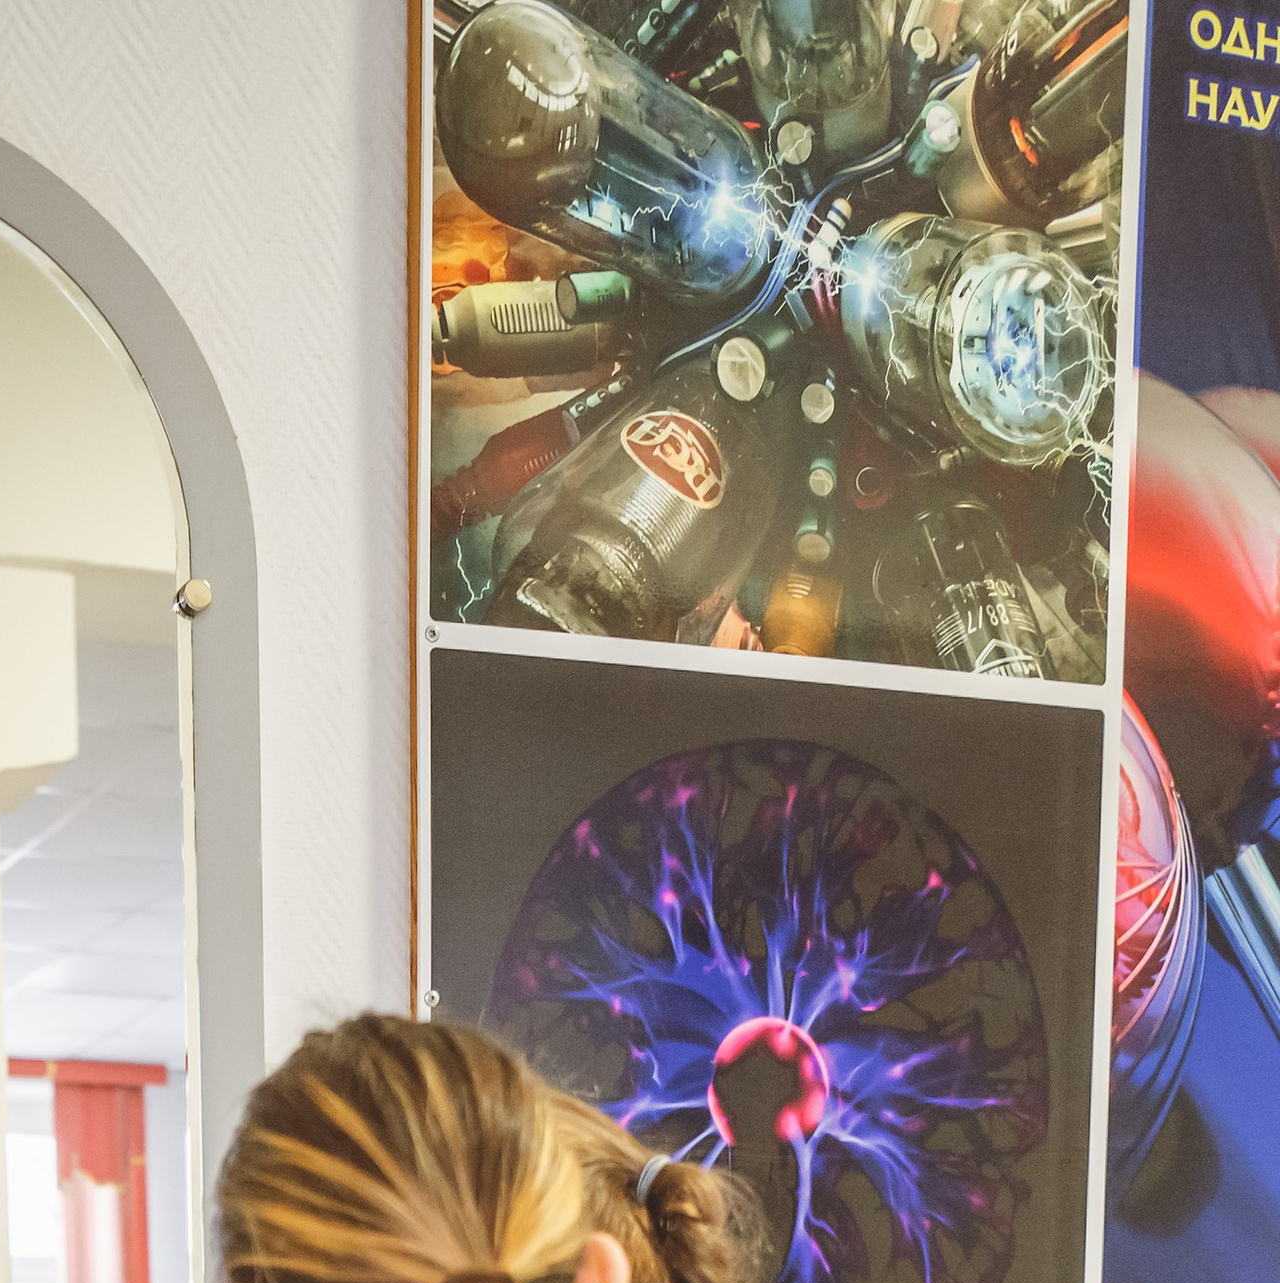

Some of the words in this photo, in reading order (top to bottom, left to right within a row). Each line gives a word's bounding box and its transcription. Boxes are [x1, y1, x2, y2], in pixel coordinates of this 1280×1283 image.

[1189, 9, 1280, 65] ОДН
[1187, 78, 1280, 130] НАУ
[967, 603, 1010, 634] 88/7
